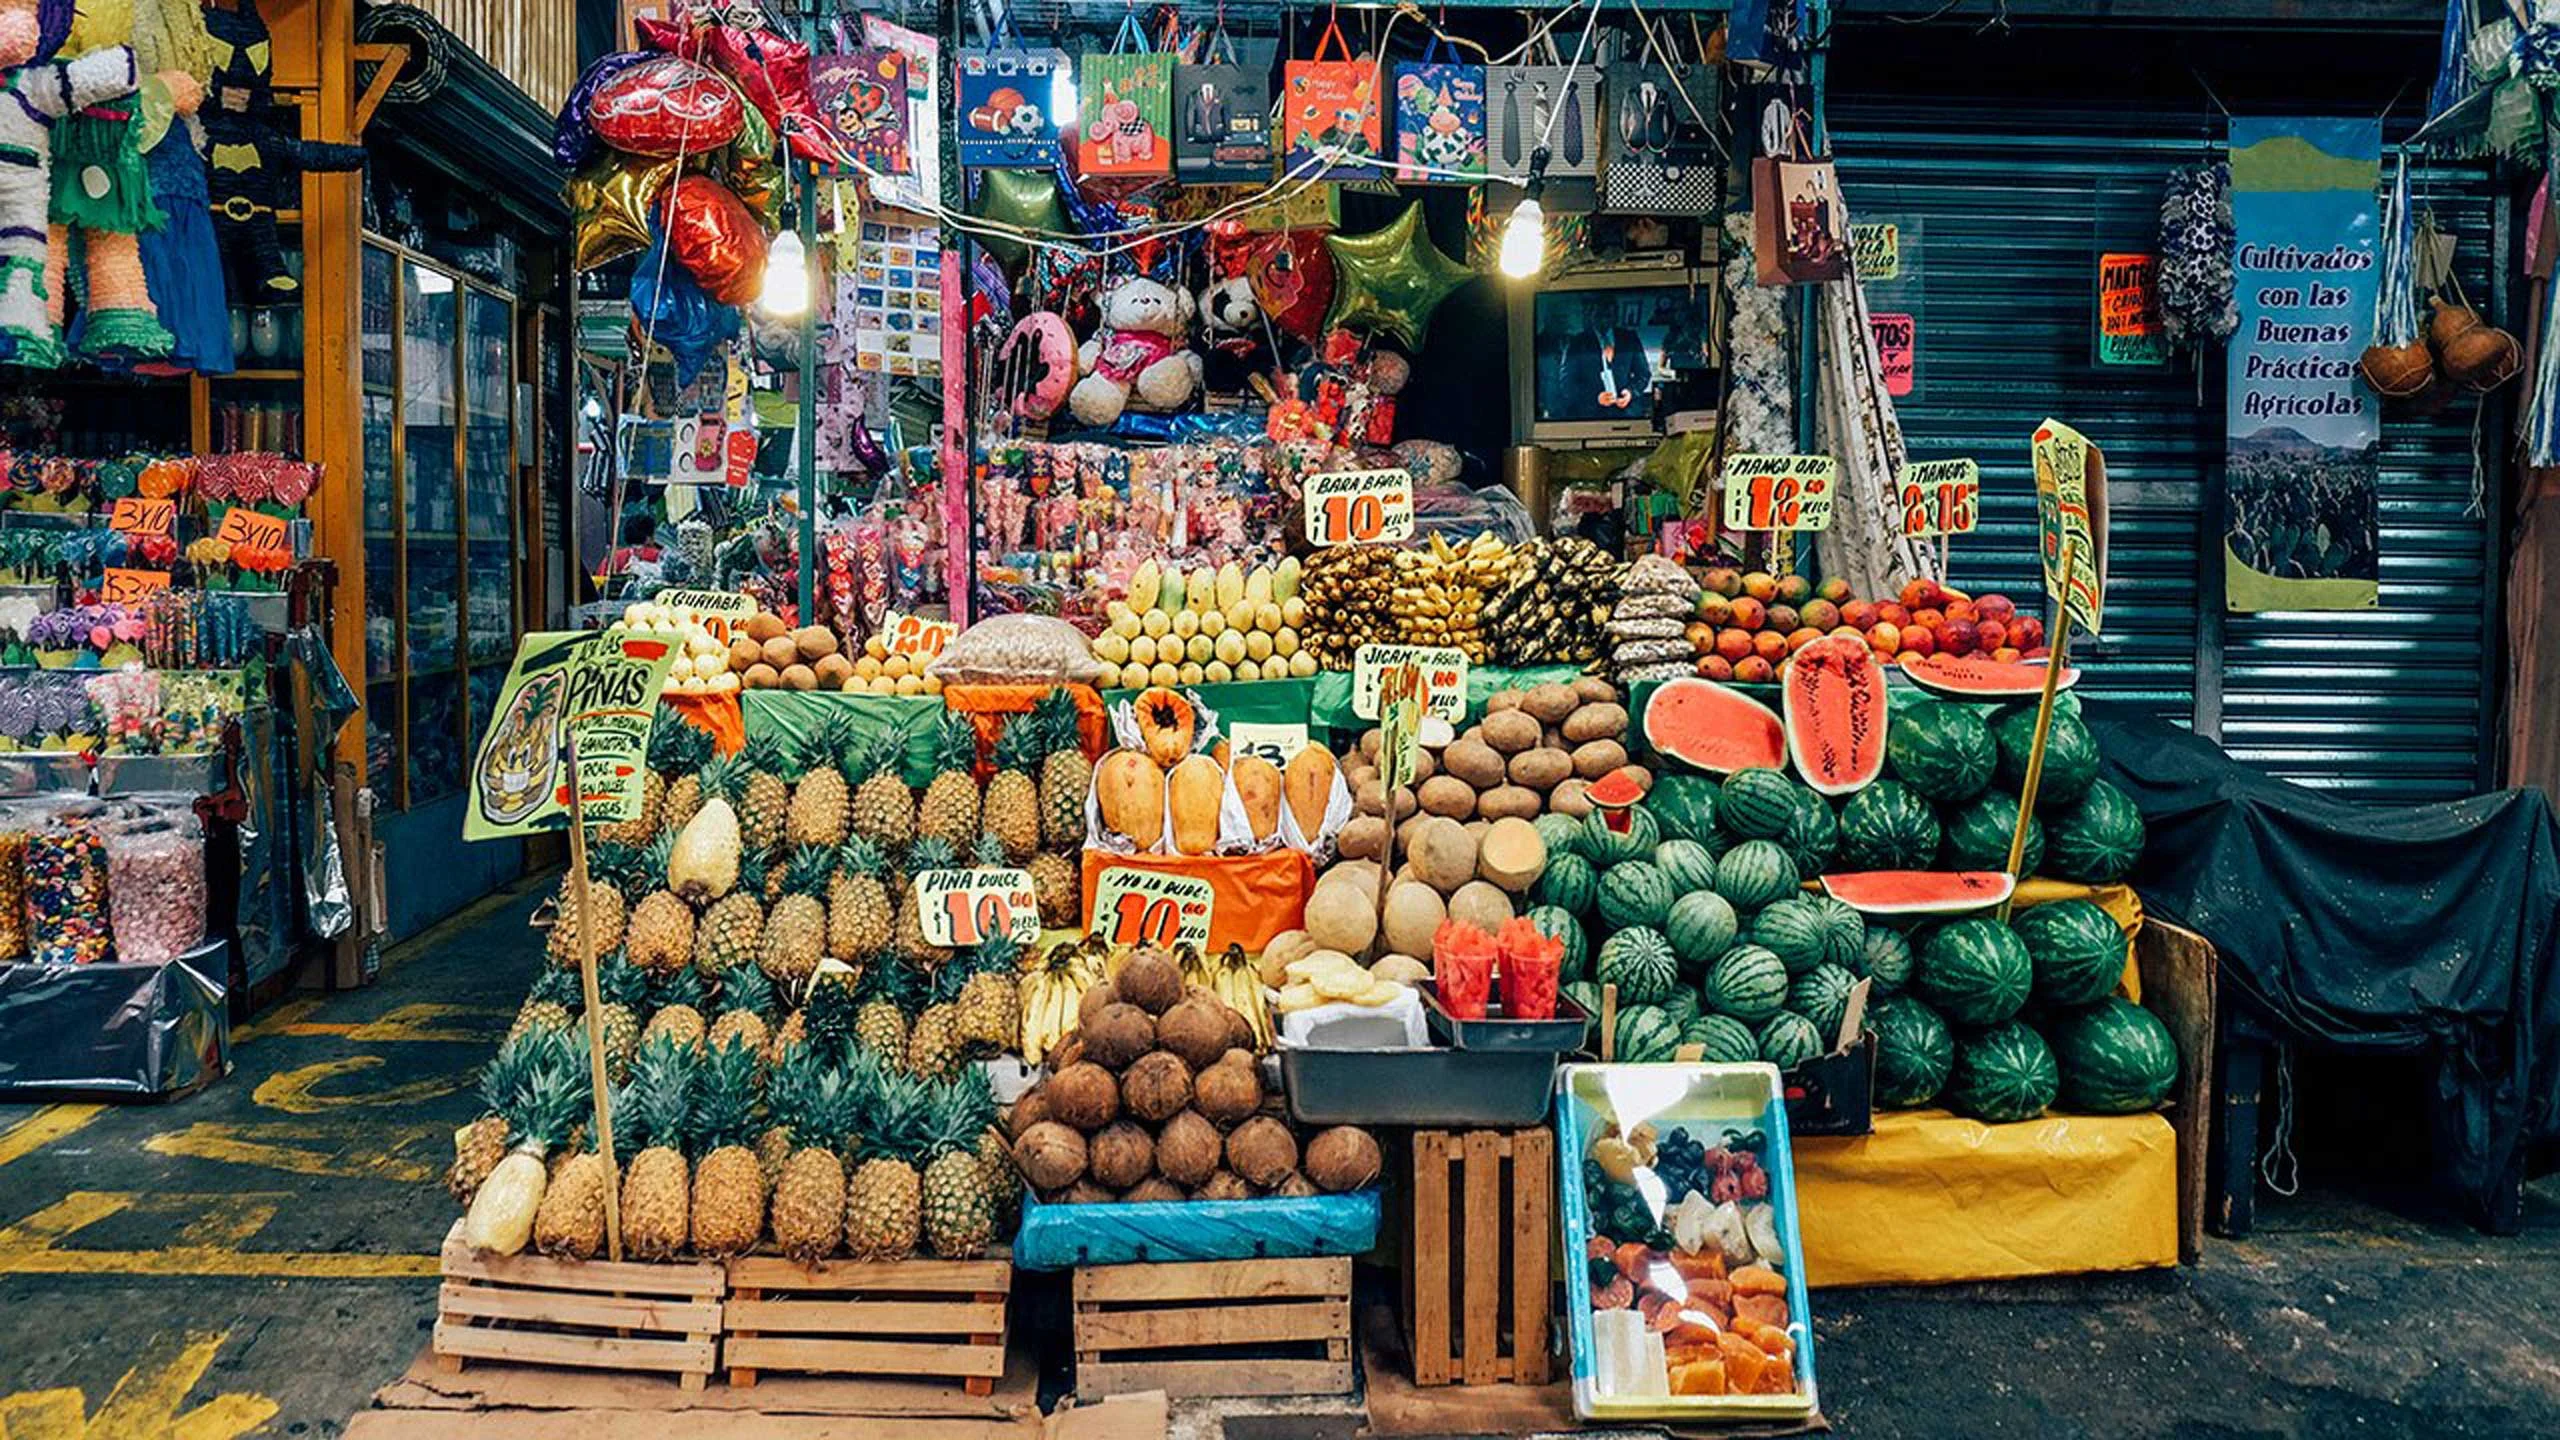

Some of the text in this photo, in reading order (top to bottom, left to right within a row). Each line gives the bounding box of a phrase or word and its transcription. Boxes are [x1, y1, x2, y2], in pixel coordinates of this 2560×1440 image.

[2238, 244, 2373, 271] Cultivados
[2257, 281, 2350, 307] con las
[2256, 317, 2351, 344] Buenas
[2244, 354, 2361, 380] Prácticas
[2243, 390, 2364, 420] Agrícolas
[1747, 476, 1801, 528] 12
[1321, 495, 1383, 542] 10
[894, 616, 945, 657] 20
[561, 660, 649, 719] PIÑAS
[977, 872, 1020, 888] DULCE
[1143, 877, 1162, 891] LO
[943, 892, 1013, 944] 10
[1112, 892, 1180, 948] 10
